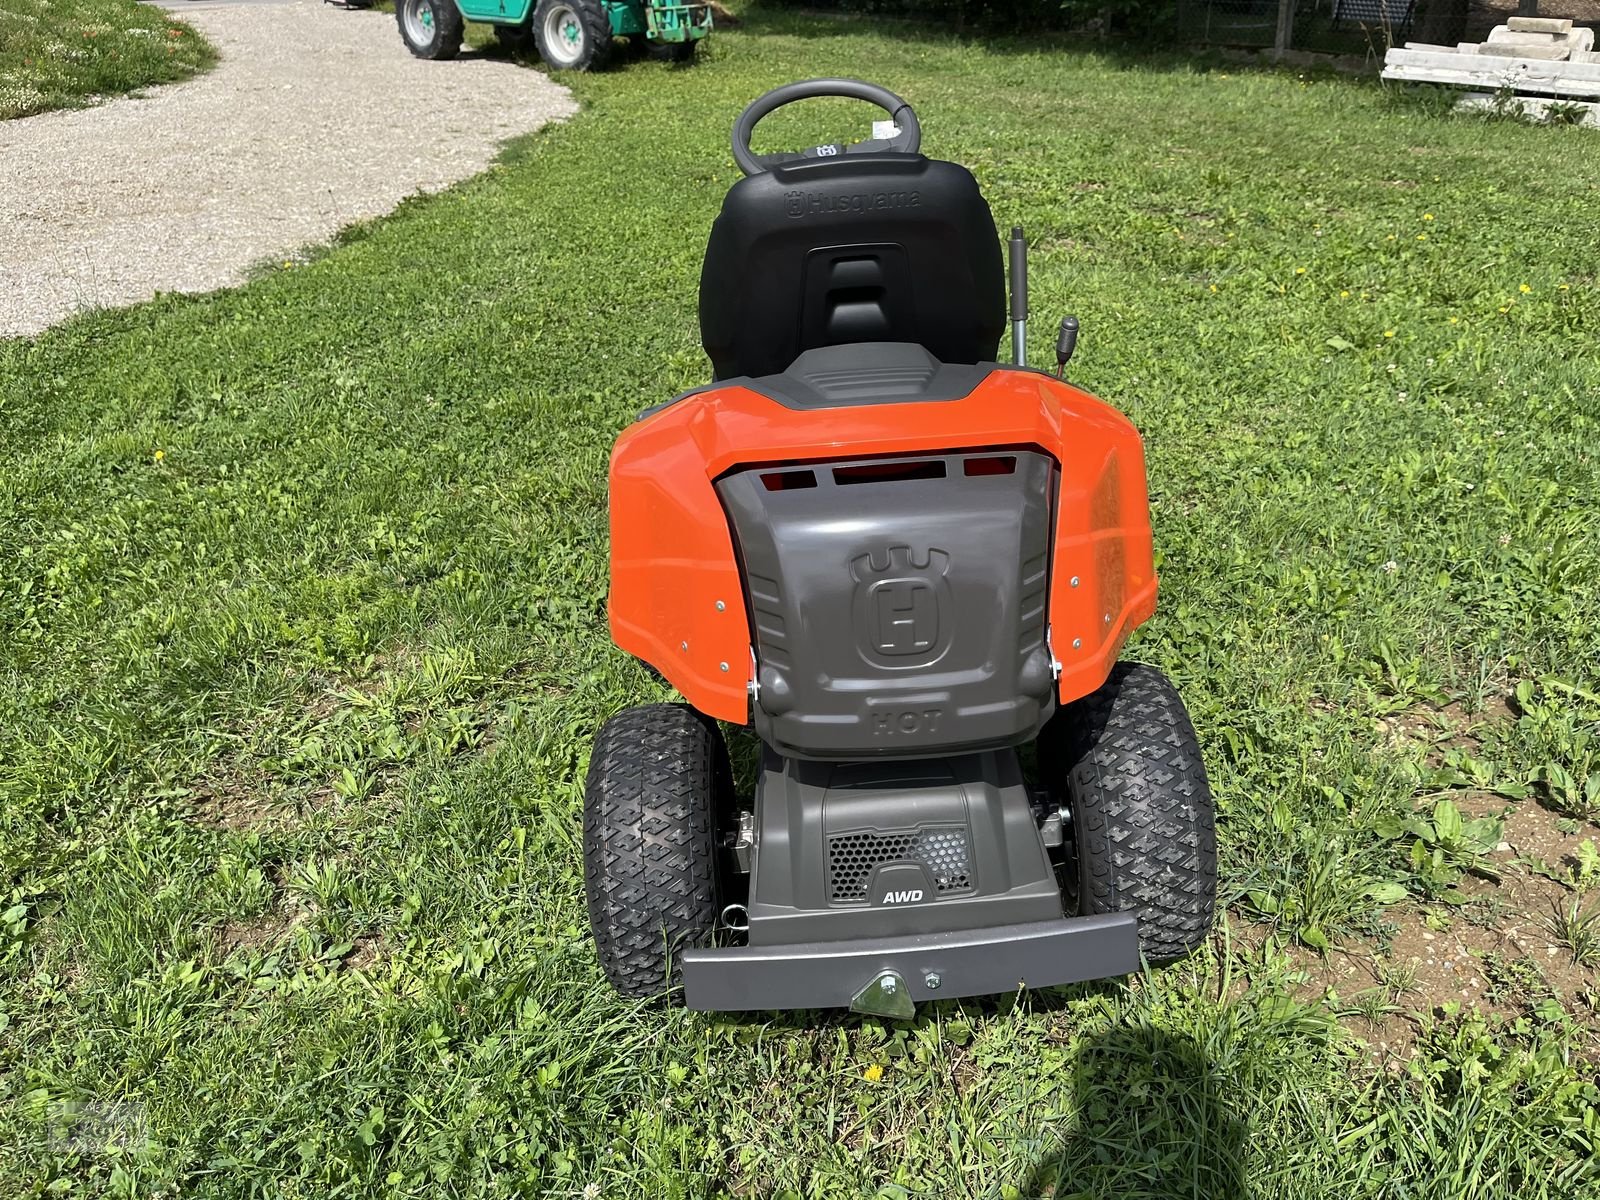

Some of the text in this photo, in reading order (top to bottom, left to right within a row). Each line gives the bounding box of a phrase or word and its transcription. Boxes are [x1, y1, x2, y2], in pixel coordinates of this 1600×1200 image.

[808, 190, 921, 214] Husqvarna
[877, 585, 929, 648] H
[872, 709, 942, 734] HOT
[882, 890, 923, 904] AWD
